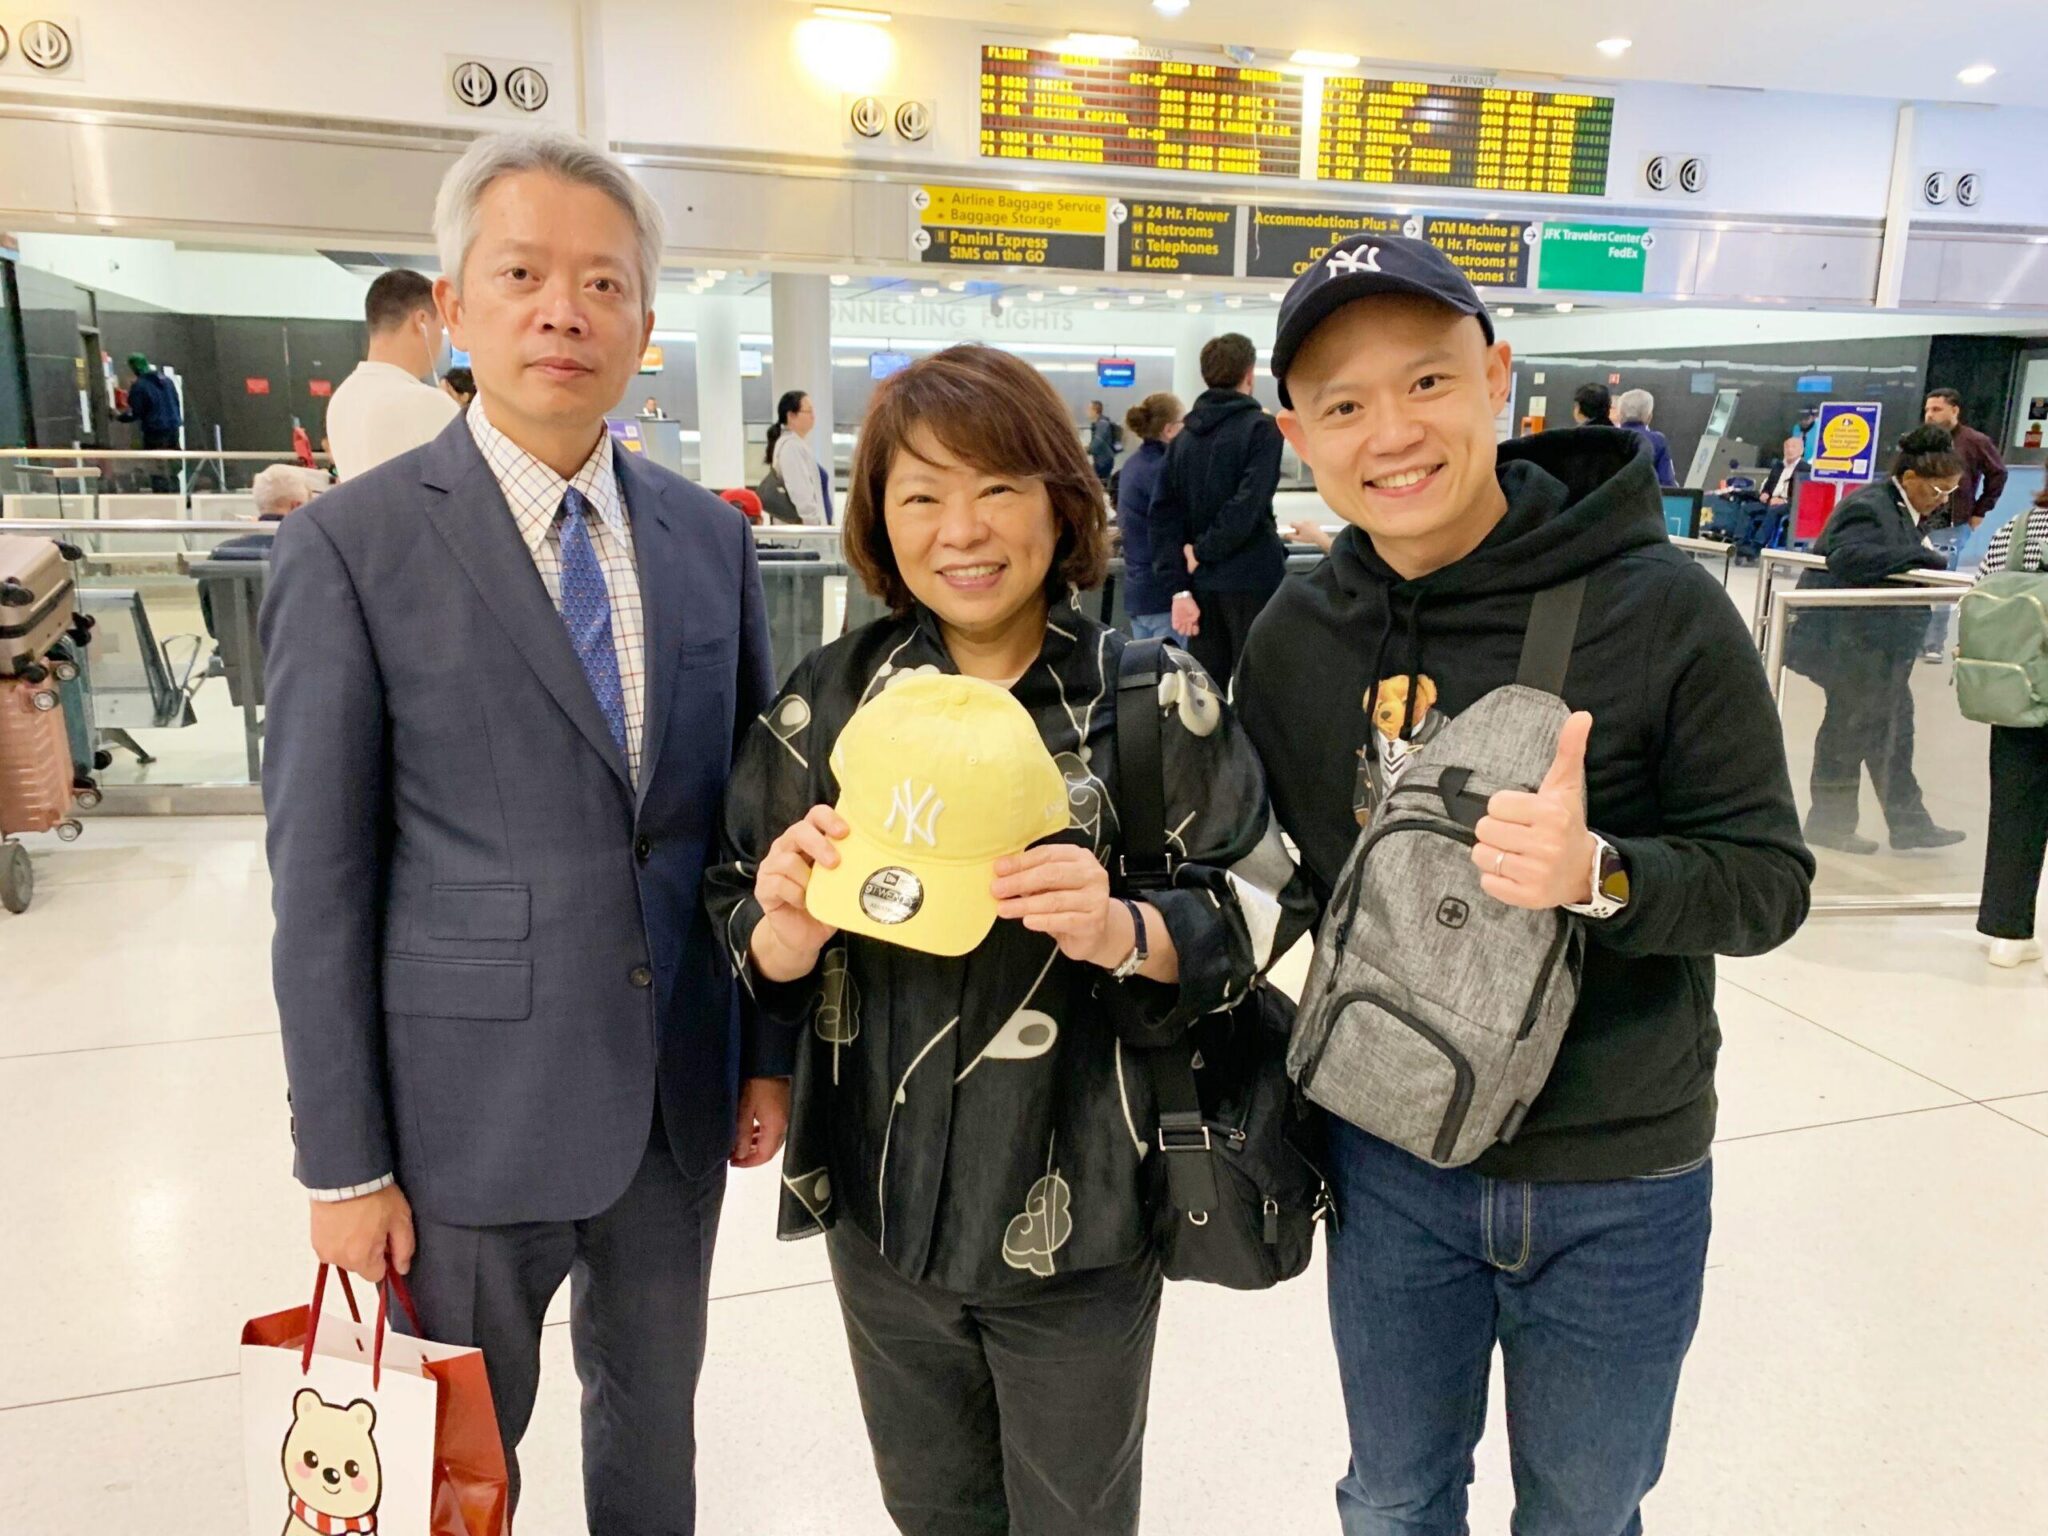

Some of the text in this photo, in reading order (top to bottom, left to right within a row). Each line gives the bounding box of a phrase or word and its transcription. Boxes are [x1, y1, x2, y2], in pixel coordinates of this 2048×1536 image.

[988, 46, 1028, 60] FLIGHT
[1161, 62, 1192, 75] SCHED
[1198, 65, 1216, 77] EST
[1450, 74, 1495, 86] ARRIVALS
[1328, 78, 1364, 90] FLIGHT
[1392, 82, 1428, 94] ORIGIN
[1483, 89, 1511, 101] SCHED
[1516, 91, 1533, 103] EST
[1034, 92, 1085, 107] ISTANBUL
[1220, 107, 1233, 119] AT
[1238, 109, 1263, 121] GATE
[1220, 94, 1233, 105] AT
[1238, 96, 1263, 108] GATE
[1368, 92, 1414, 107] ISTANBUL
[1033, 106, 1079, 120] BEIJING
[1084, 110, 1129, 125] CAPITAL
[1367, 119, 1396, 131] PARIS
[1552, 132, 1574, 143] TIME
[1553, 119, 1575, 131] TIME
[1052, 135, 1104, 150] SALVADOR
[1366, 132, 1412, 145] ISTANBUL
[1551, 145, 1573, 156] TIME
[1033, 147, 1104, 163] GUADALAJARA
[1365, 145, 1394, 157] SEOUL
[1411, 148, 1451, 160] INCHEON
[1550, 157, 1571, 168] TIME
[1364, 157, 1394, 170] SEOUL
[1410, 160, 1451, 173] INCHEON
[1548, 169, 1570, 181] TIME
[1364, 170, 1393, 182] CAIRO
[1548, 182, 1569, 193] TIME
[951, 192, 1102, 213] Airline Baggage Service
[951, 209, 1062, 228] Baggage Storage
[1147, 206, 1230, 223] 24 Hr. Flower
[1254, 211, 1387, 231] Accommodations Plus
[1146, 223, 1214, 238] Restrooms
[1429, 221, 1508, 237] ATM Machine
[1544, 228, 1641, 244] JFK Travelers Center
[950, 231, 1048, 249] Panini Express
[1146, 239, 1219, 255] Telephones
[1447, 238, 1463, 250] Hr.
[1466, 239, 1506, 252] Flower
[950, 247, 1046, 263] SIMS on the GO
[1145, 255, 1179, 268] Lotto
[1608, 247, 1638, 259] FedEx
[981, 306, 1074, 332] FLIGHTS
[884, 777, 945, 848] NY
